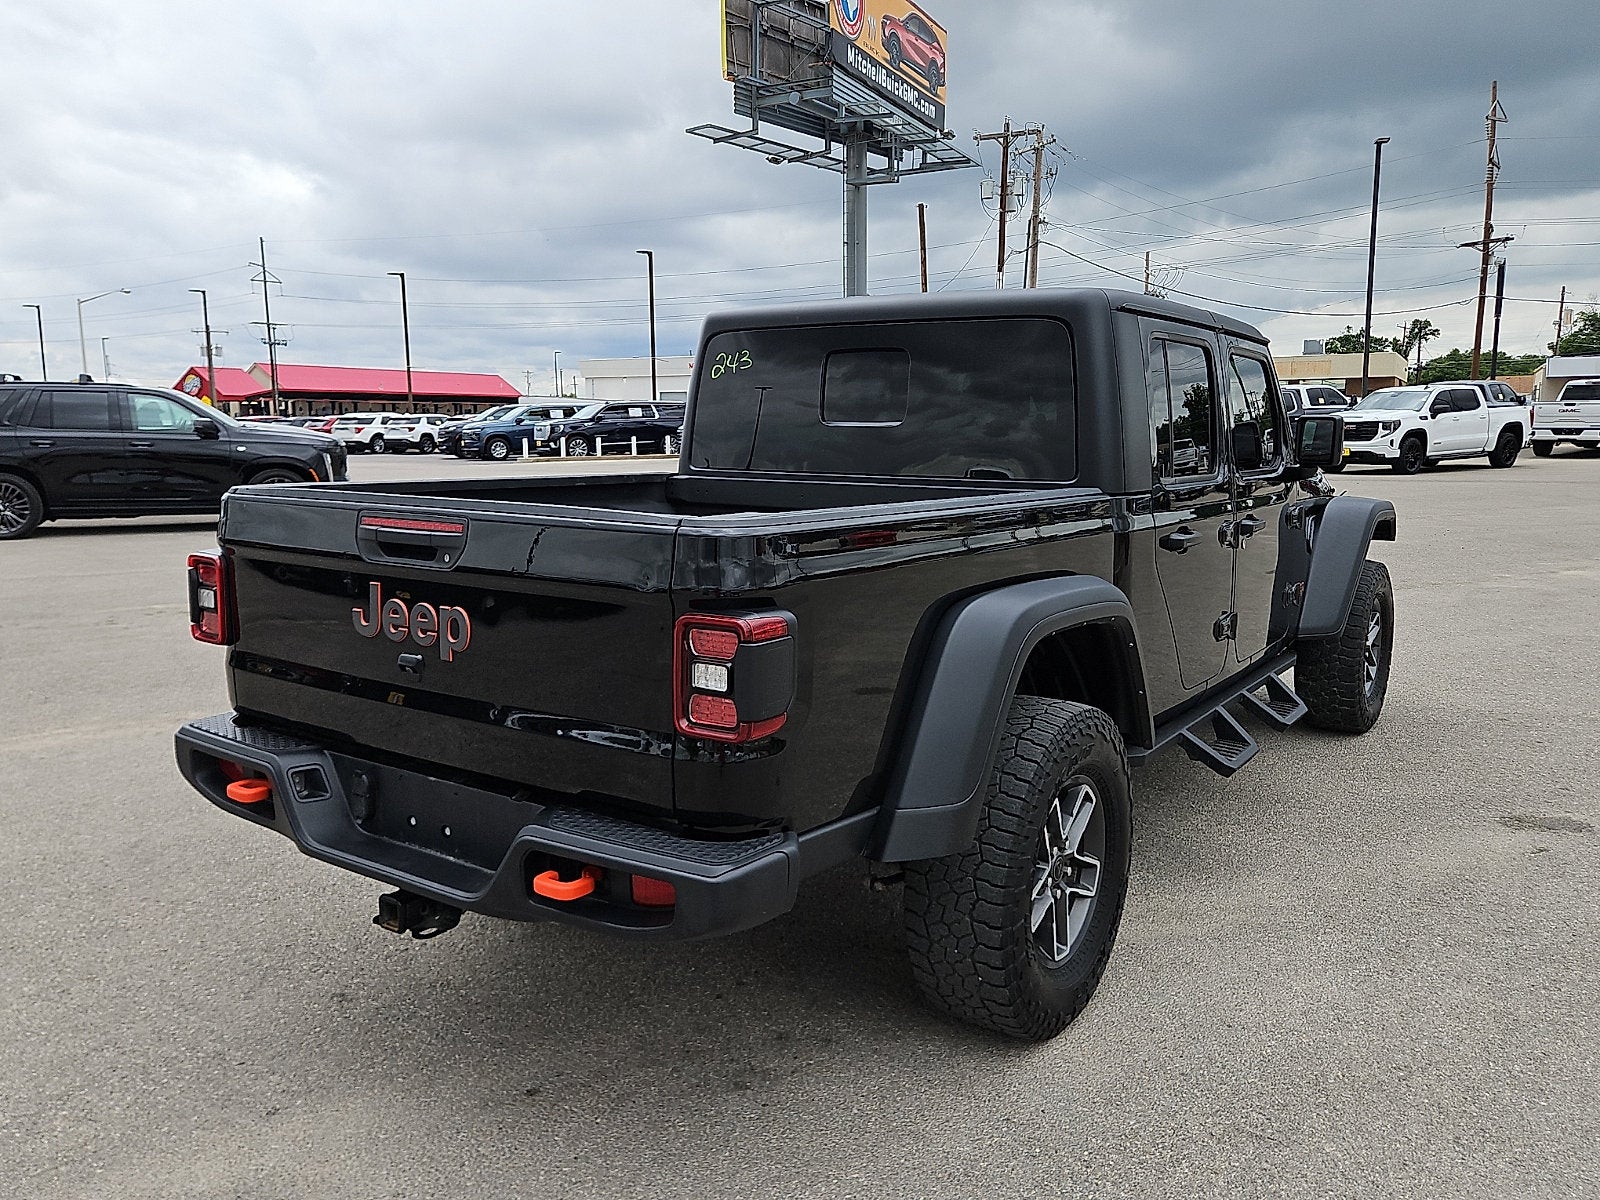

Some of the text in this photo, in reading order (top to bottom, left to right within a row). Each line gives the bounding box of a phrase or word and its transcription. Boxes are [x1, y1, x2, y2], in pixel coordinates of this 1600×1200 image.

[847, 44, 936, 119] MitchellBuickGMC.com
[711, 350, 753, 379] 243
[351, 581, 471, 662] Jeep
